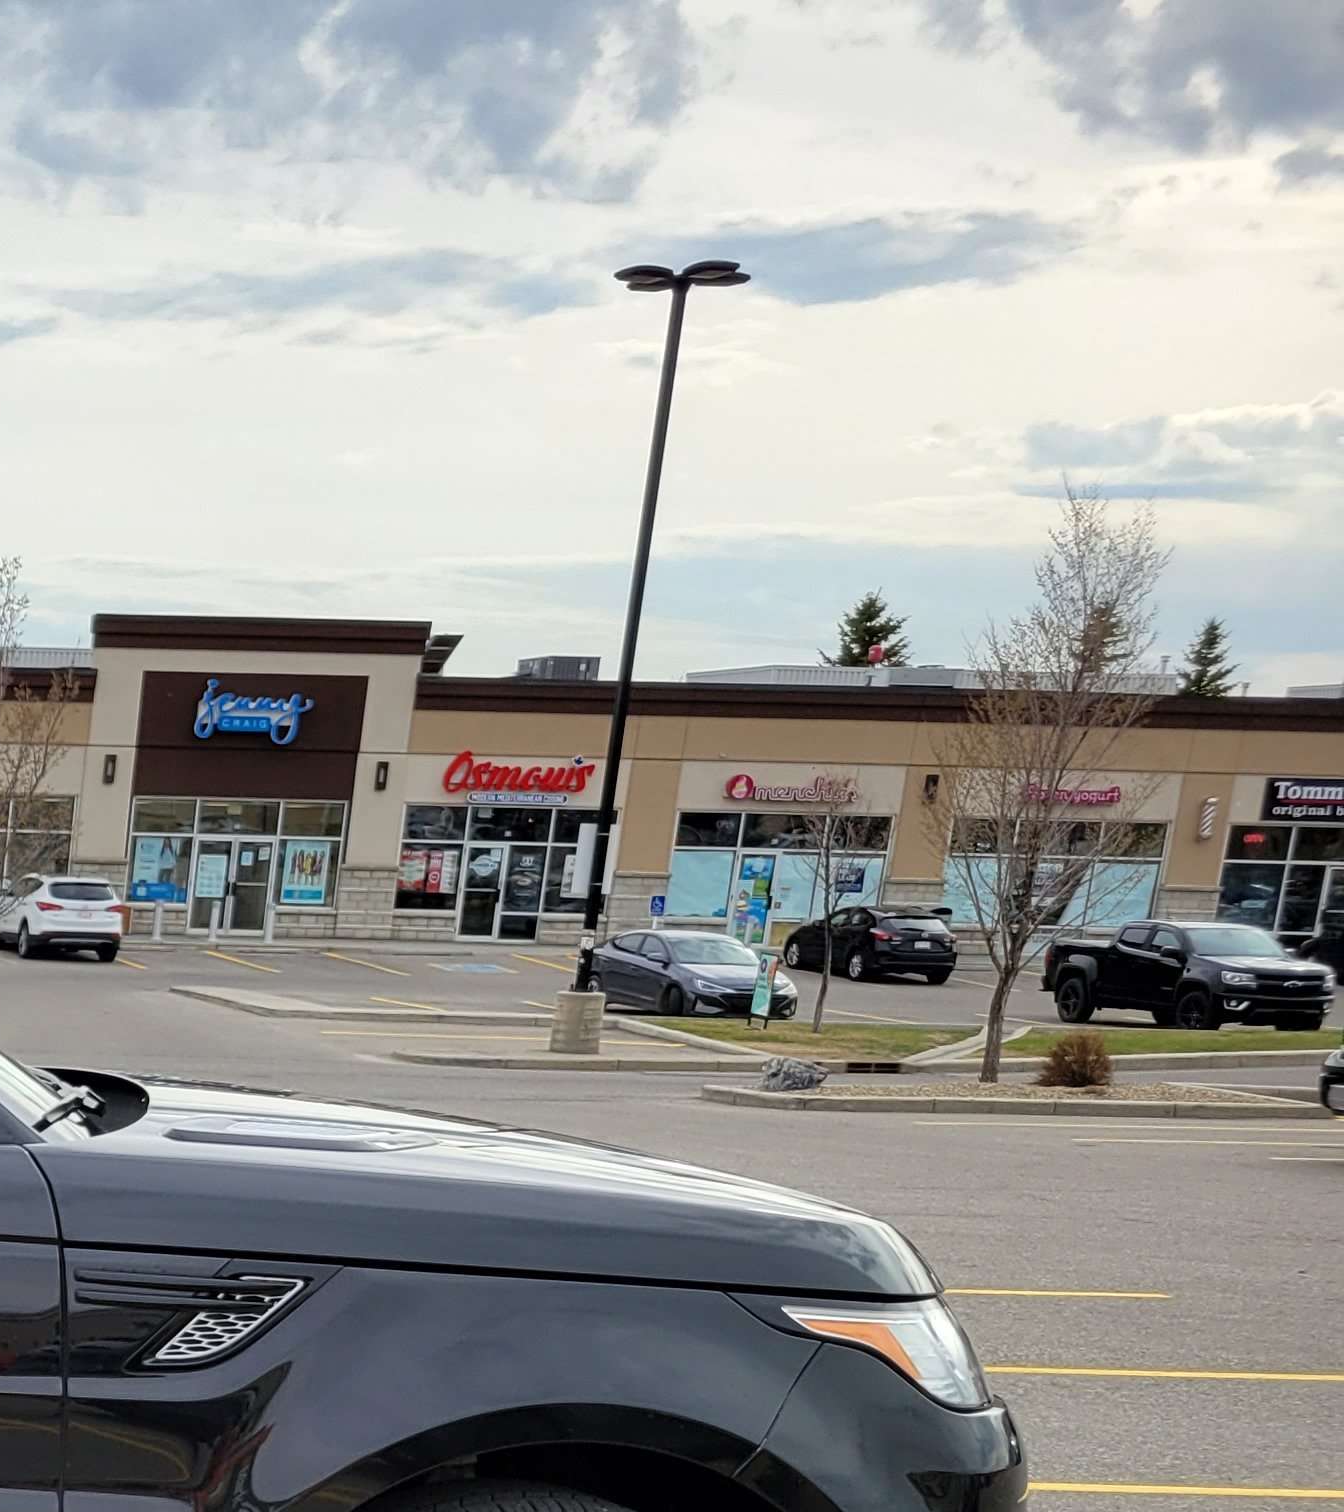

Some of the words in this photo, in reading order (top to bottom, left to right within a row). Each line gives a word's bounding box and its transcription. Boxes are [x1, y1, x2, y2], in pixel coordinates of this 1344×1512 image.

[222, 719, 267, 729] CRAIG
[1073, 785, 1119, 804] yogurt
[1272, 805, 1331, 817] original
